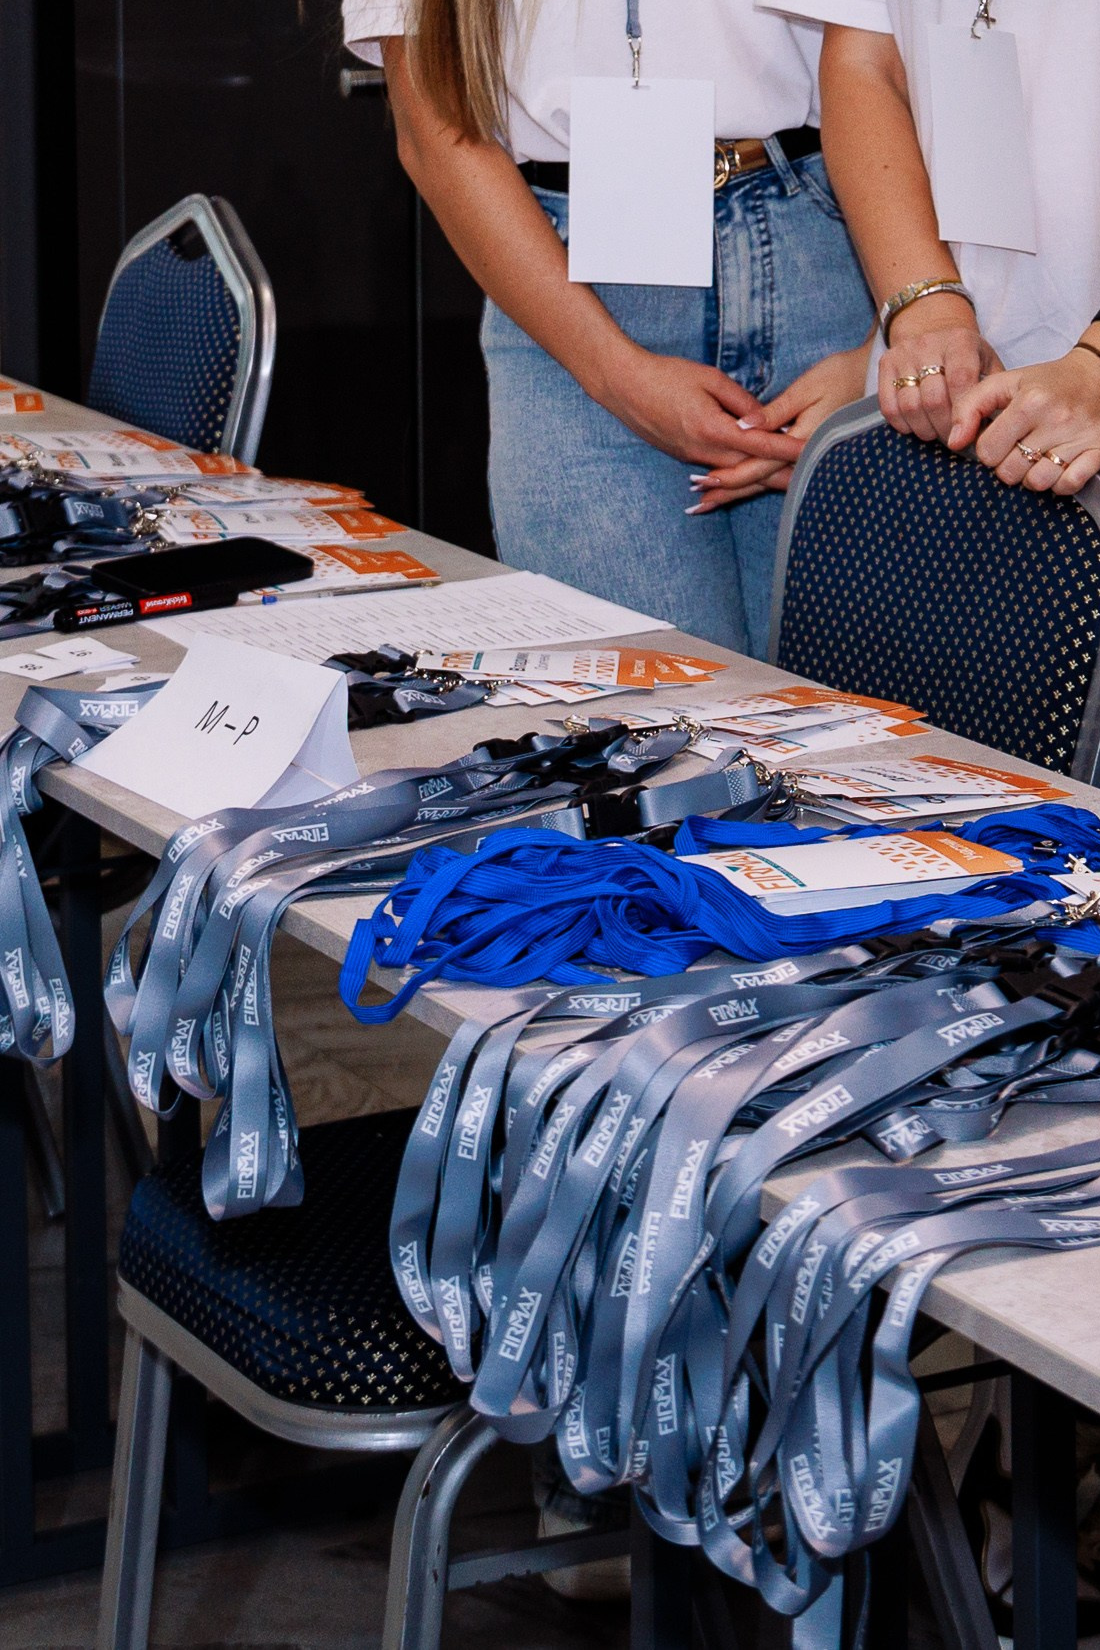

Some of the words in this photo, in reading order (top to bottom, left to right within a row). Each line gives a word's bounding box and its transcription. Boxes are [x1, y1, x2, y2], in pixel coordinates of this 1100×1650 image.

[79, 609, 134, 625] PERMANENT
[80, 699, 140, 718] FIRMAX
[418, 776, 453, 801] FIRMAX
[168, 818, 225, 863] FIRMAX
[271, 823, 329, 843] FIRMAX
[227, 850, 284, 890] FIRMAX
[709, 852, 796, 891] FIRMAX
[162, 874, 194, 940] FIRMAX
[5, 948, 30, 1009] FIRMAX
[567, 993, 642, 1012] FIRMAX
[730, 961, 800, 990] FIRMAX
[50, 978, 70, 1040] FIRMAX
[708, 998, 760, 1027] FIRMAX
[936, 1012, 1005, 1047] FIRMAX
[171, 1018, 197, 1077] FIRMAX
[213, 1011, 229, 1079] FIRMAX
[774, 1030, 850, 1070] FIRMAX
[420, 1062, 457, 1138] FIRMAX
[458, 1085, 493, 1161] FIRMAX
[583, 1090, 632, 1168] FIRMAX
[777, 1084, 854, 1138] FIRMAX
[237, 1131, 260, 1199] FIRMAX
[533, 1102, 576, 1180] FIRMAX
[670, 1139, 709, 1220] FIRMAX
[934, 1164, 1014, 1185] FIRMAX
[756, 1195, 820, 1269] FIRMAX
[398, 1240, 433, 1314] FIRMAX
[790, 1240, 828, 1325] FIRMAX
[440, 1275, 467, 1351] FIRMAX
[499, 1286, 542, 1363] FIRMAX
[565, 1380, 591, 1460] FIRMAX
[655, 1353, 678, 1436] FIRMAX
[790, 1453, 838, 1540] FIRMAX
[864, 1457, 902, 1533] FIRMAX
